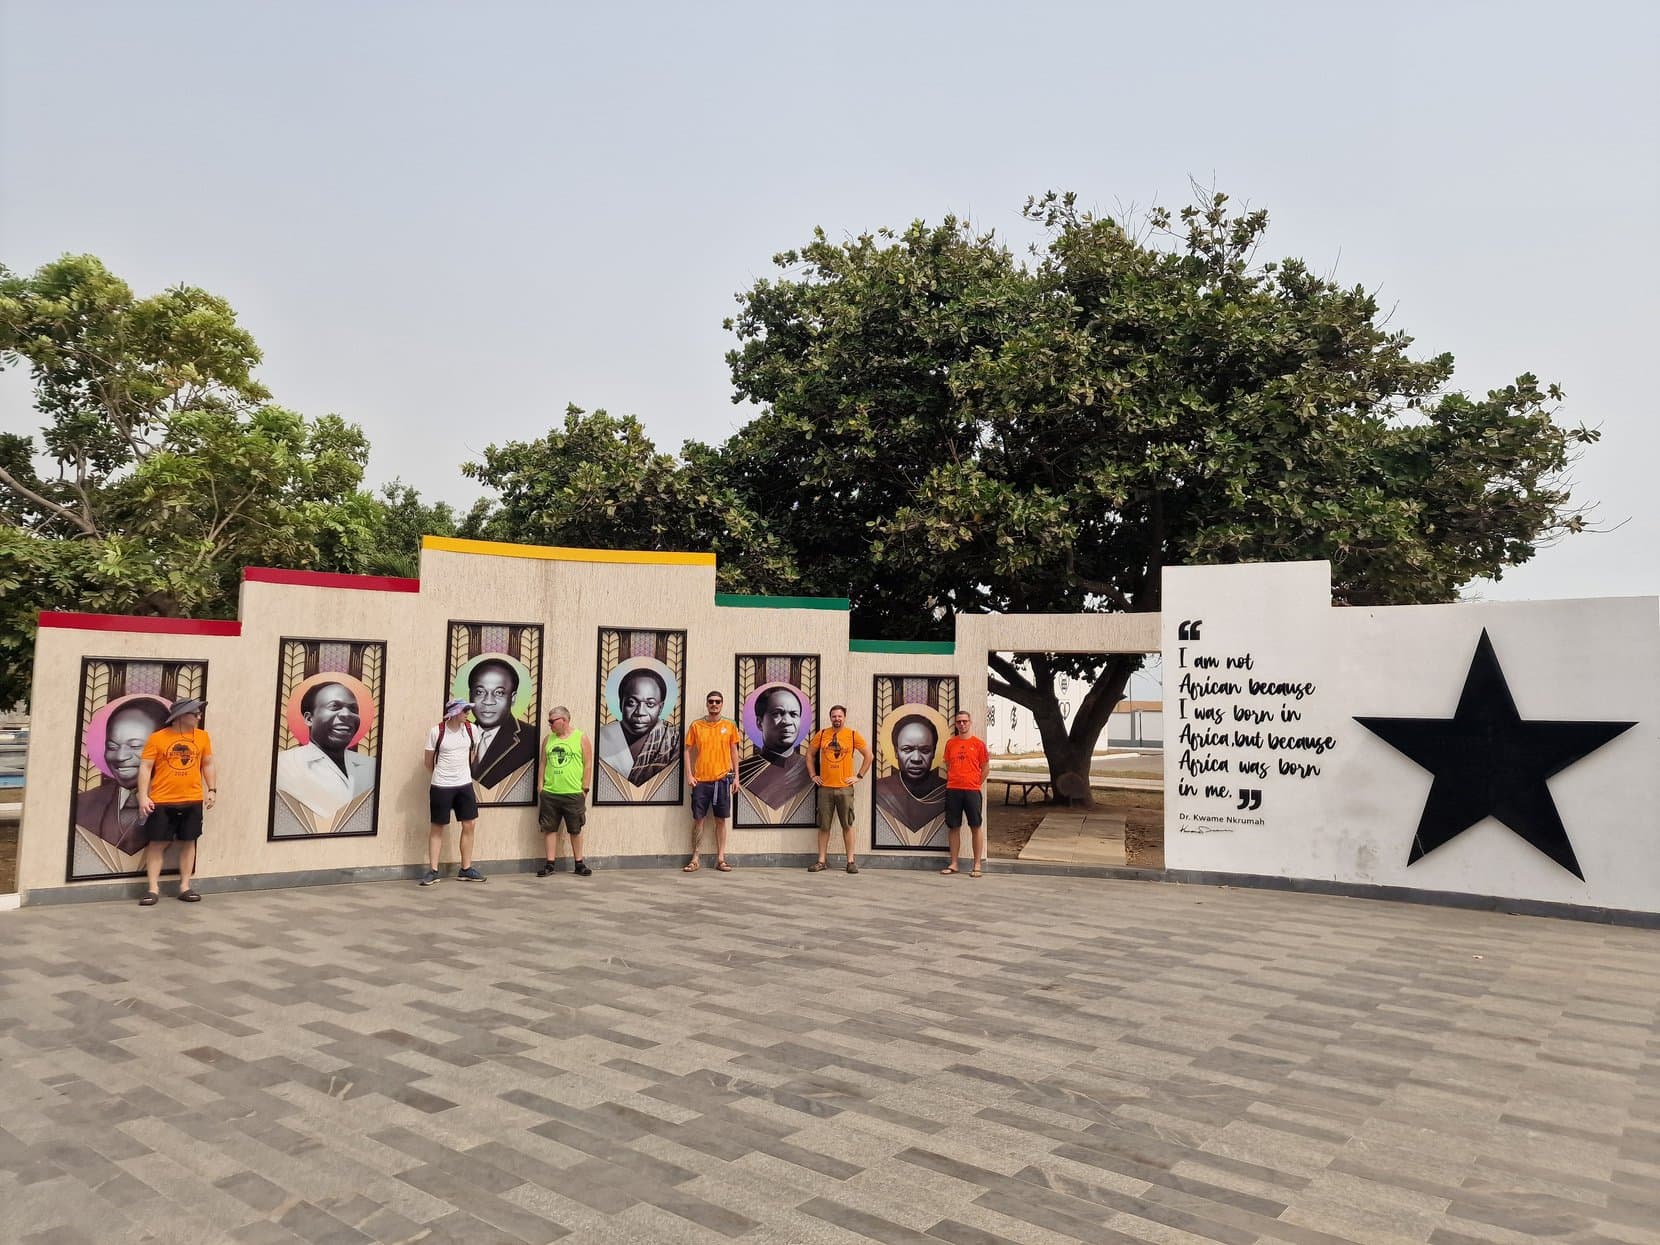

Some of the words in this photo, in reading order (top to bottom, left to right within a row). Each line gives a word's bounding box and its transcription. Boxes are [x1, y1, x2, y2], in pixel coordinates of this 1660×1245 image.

[1179, 647, 1187, 668] I
[1194, 656, 1219, 669] am
[1227, 653, 1254, 670] not
[1179, 673, 1241, 700] African
[1249, 678, 1315, 700] because
[1179, 698, 1187, 719] I
[1194, 707, 1225, 724] was
[1234, 705, 1274, 724] born
[1281, 704, 1301, 722] in
[1268, 733, 1336, 754] because
[1179, 749, 1229, 777] Africa
[1239, 760, 1270, 778] was
[1279, 758, 1320, 778] born
[1179, 778, 1197, 796] in
[1205, 785, 1232, 798] me.
[1193, 814, 1224, 822] Kwame
[1226, 816, 1265, 825] Nkrumah
